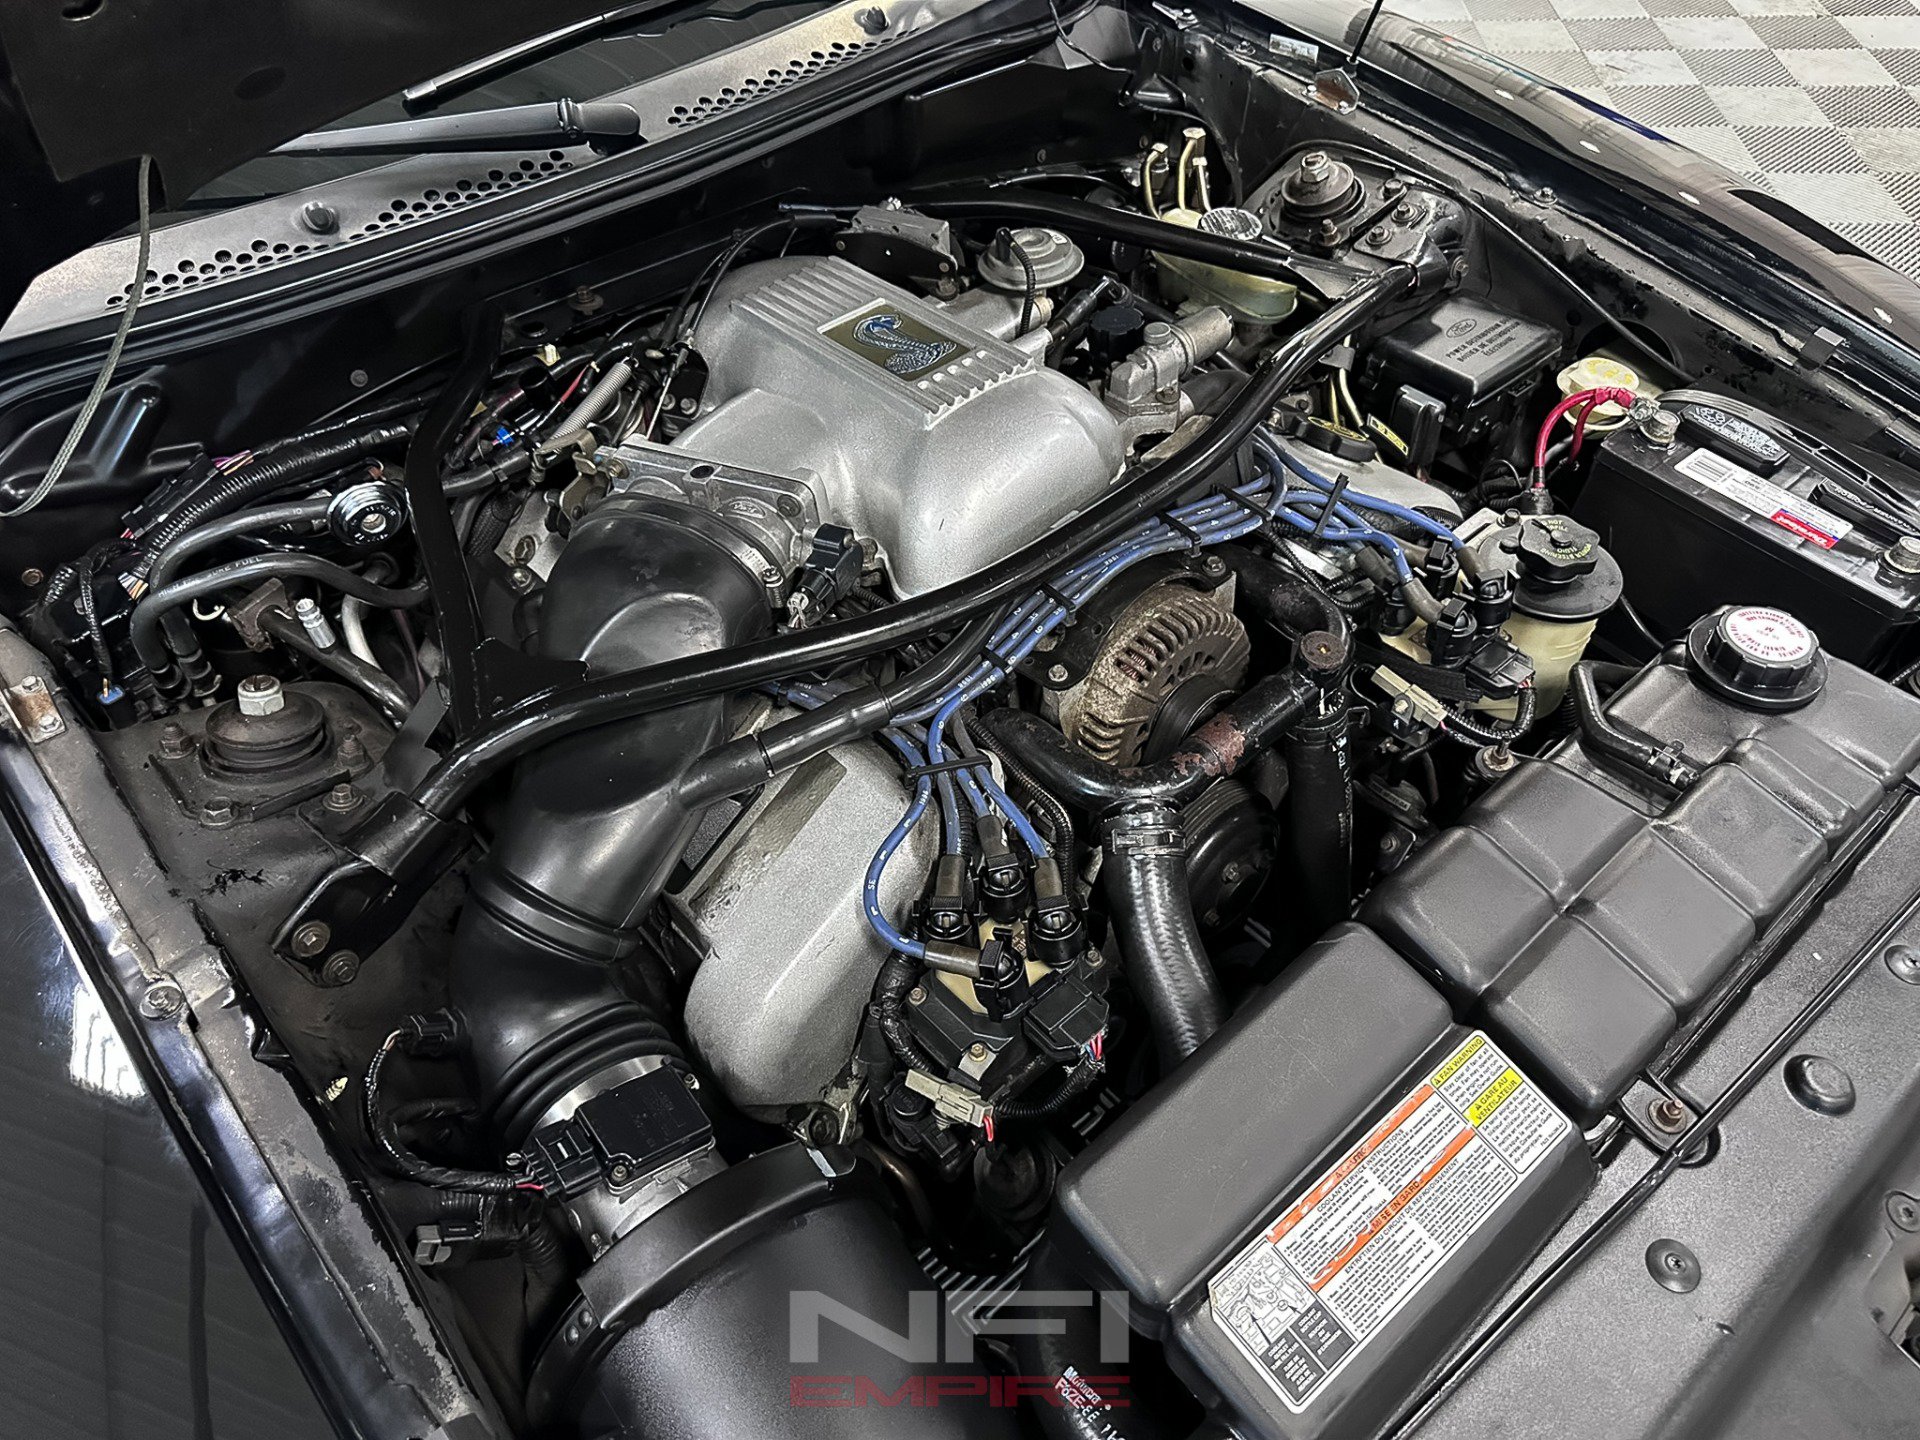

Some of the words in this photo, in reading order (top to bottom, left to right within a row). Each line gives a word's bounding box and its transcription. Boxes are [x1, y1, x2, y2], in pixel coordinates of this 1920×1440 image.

[1446, 343, 1467, 358] POWER
[1776, 514, 1827, 545] Duralast
[235, 555, 261, 568] FUEL
[1540, 548, 1573, 558] STEERING
[1439, 1065, 1453, 1079] FAN
[1453, 1037, 1482, 1066] WARNING
[1461, 1075, 1470, 1085] Fan
[1477, 1053, 1494, 1069] operate
[1443, 1081, 1454, 1092] Stay
[1453, 1071, 1465, 1082] clear
[1469, 1058, 1478, 1066] fan
[1464, 1076, 1480, 1092] engine
[1482, 1065, 1490, 1074] not
[1468, 1087, 1478, 1097] See
[1476, 1074, 1491, 1089] Owner
[1476, 1079, 1517, 1120] VENTILATEUR
[1480, 1086, 1498, 1104] GARE
[1497, 1076, 1508, 1088] AU
[1498, 1112, 1521, 1135] ventilateur
[1520, 1102, 1532, 1114] peut
[1508, 1105, 1518, 1115] tout
[1524, 1115, 1540, 1130] moteur
[1540, 1112, 1552, 1124] Guide
[1316, 1186, 1344, 1212] COOLANT
[1342, 1164, 1367, 1187] SERVICE
[1365, 1128, 1403, 1166] INSTRUCTIONS
[1374, 1234, 1384, 1244] DU
[1382, 1212, 1405, 1235] CIRCUIT
[1404, 1204, 1413, 1214] DE
[1411, 1158, 1459, 1206] REFROIDISSEMENT
[1389, 1199, 1401, 1211] EN
